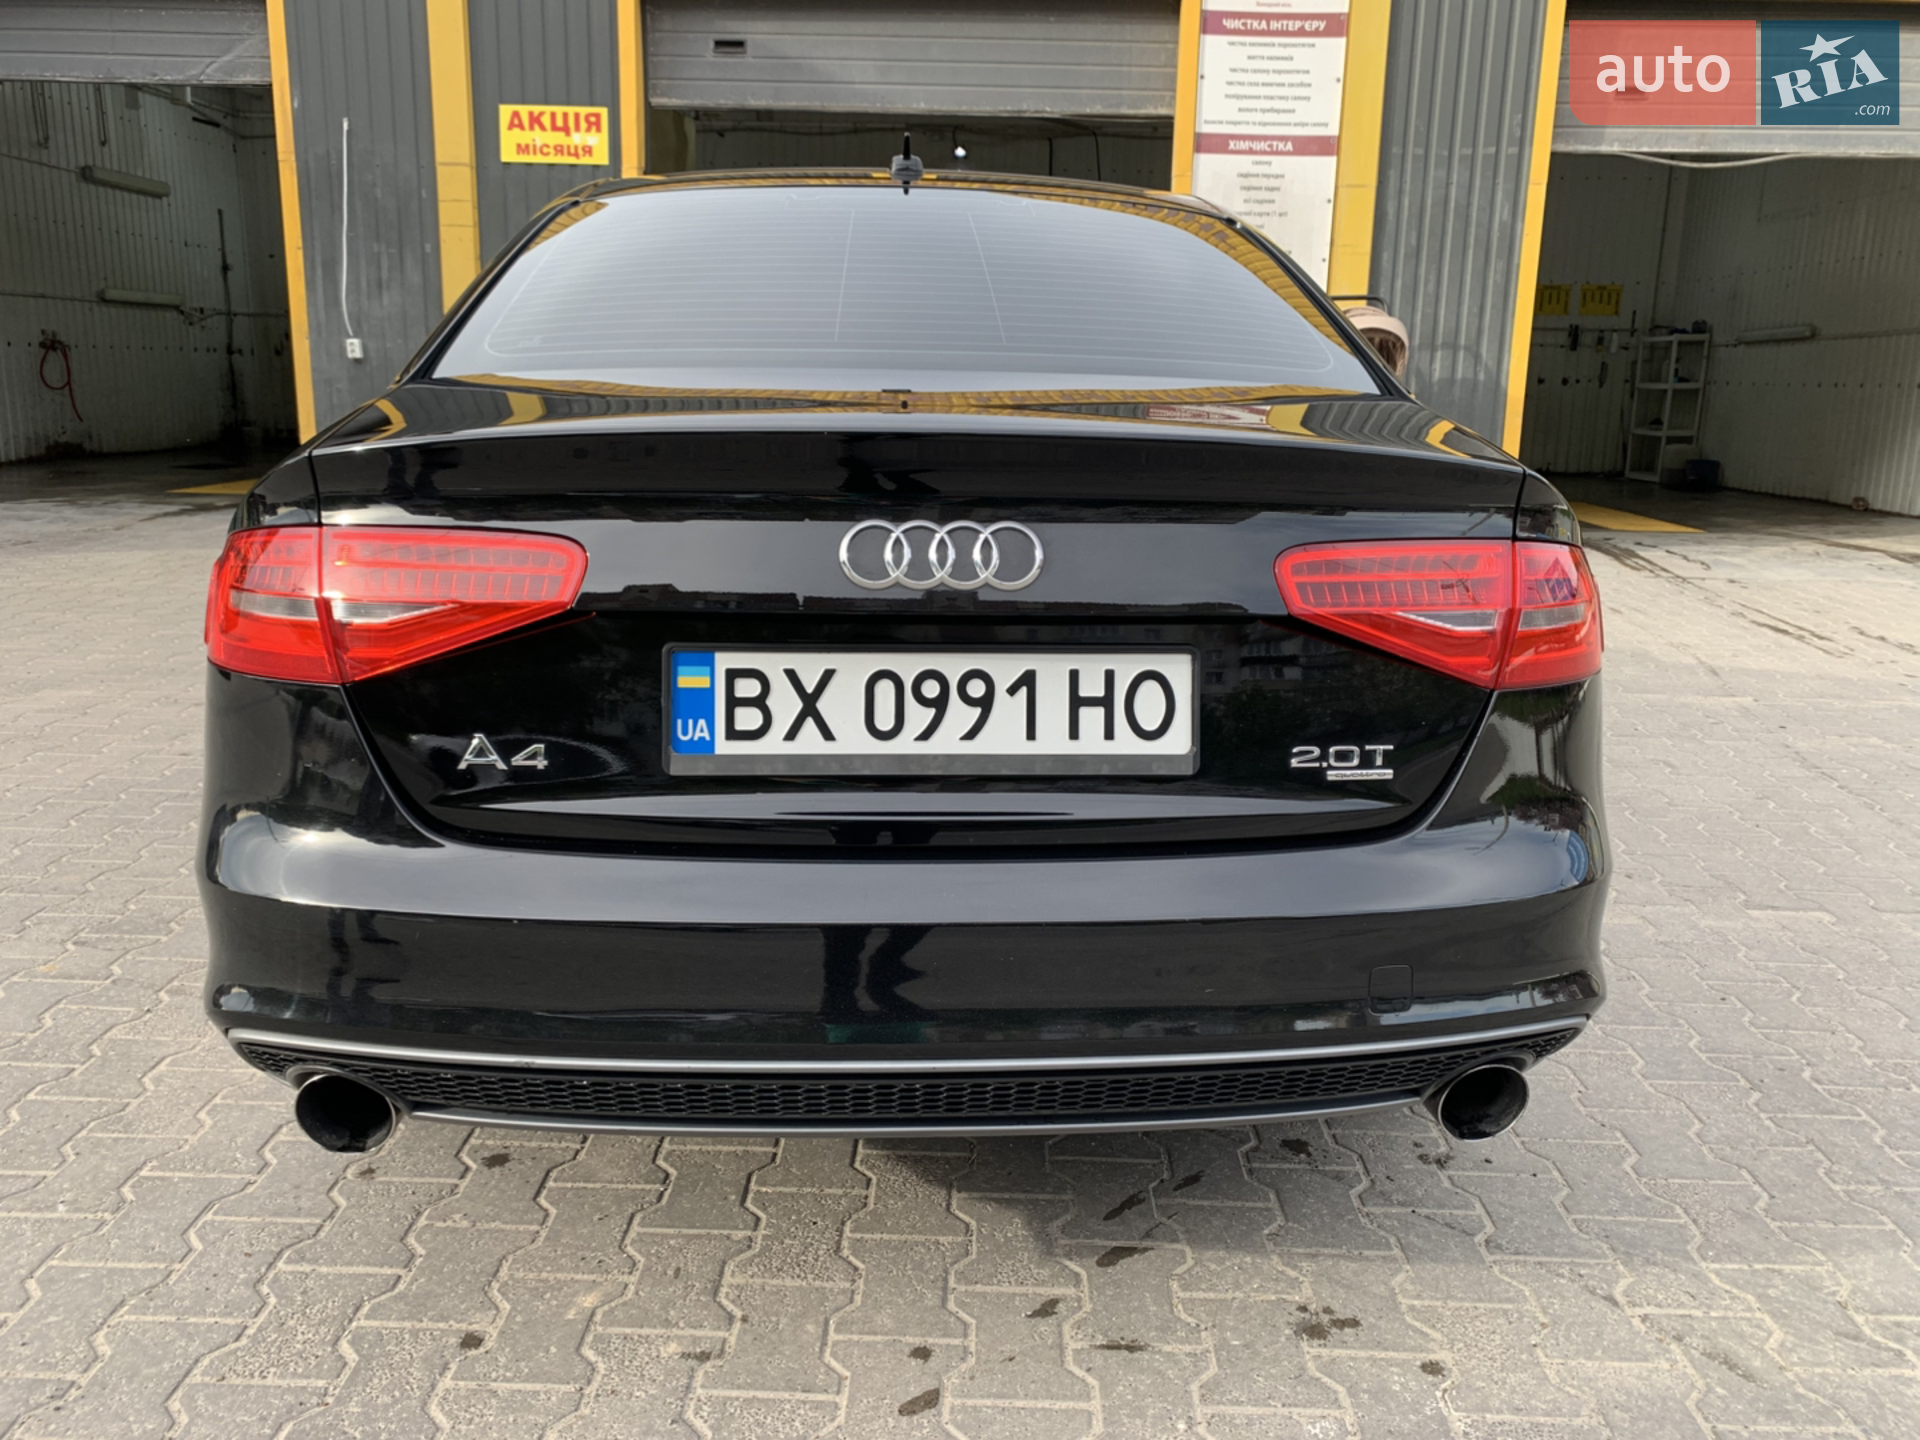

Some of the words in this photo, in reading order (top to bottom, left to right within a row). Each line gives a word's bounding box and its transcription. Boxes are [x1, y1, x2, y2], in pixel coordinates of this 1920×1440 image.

[1222, 18, 1268, 30] ЧИСТКА
[1270, 20, 1326, 31] ІНТЕР'ЄРУ
[507, 110, 602, 137] АКЦІЯ
[516, 138, 593, 160] місяця
[1228, 140, 1293, 151] ХІМЧИСТКА
[724, 667, 836, 741] BX
[864, 668, 1036, 741] 0991
[1068, 668, 1176, 741] HO
[676, 719, 710, 741] UA
[457, 733, 548, 770] A4
[1290, 745, 1394, 768] 2.0T
